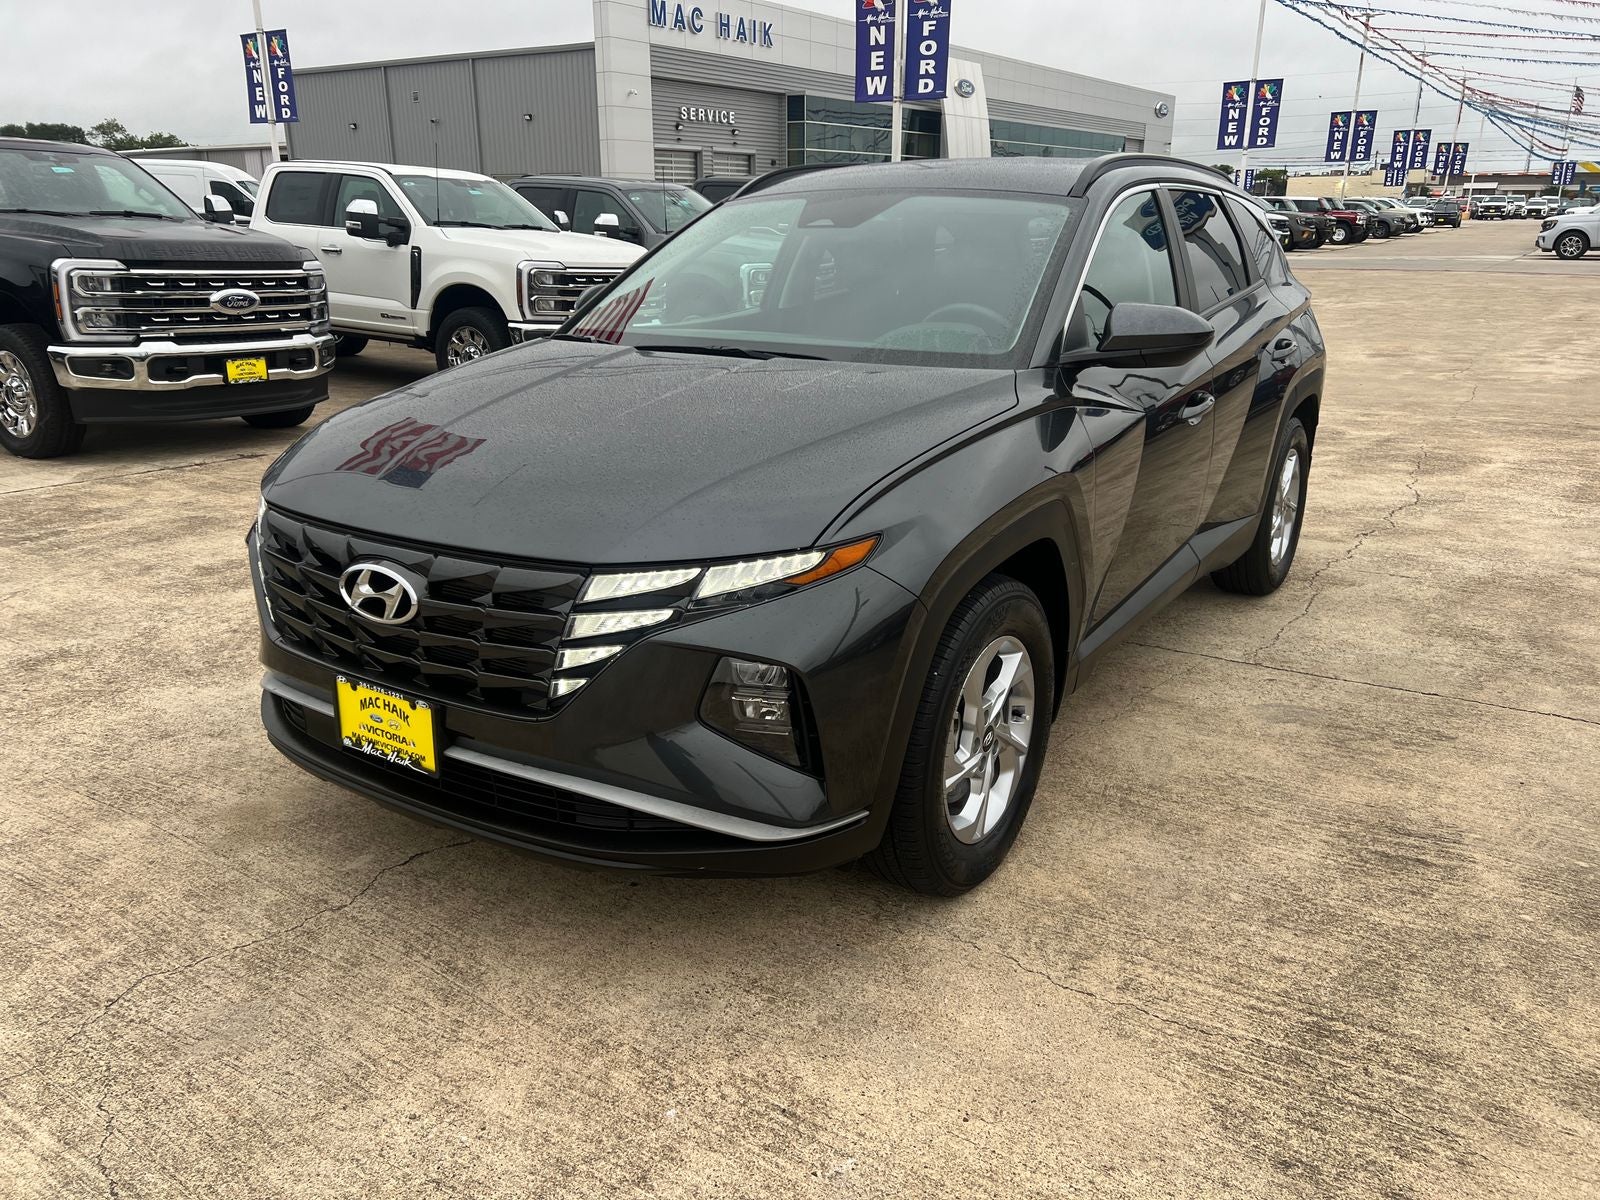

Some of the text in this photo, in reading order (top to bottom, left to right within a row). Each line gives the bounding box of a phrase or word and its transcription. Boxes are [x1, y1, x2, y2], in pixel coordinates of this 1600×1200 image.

[650, 0, 773, 47] MAC HAIK
[865, 25, 887, 95] NEW
[918, 20, 937, 93] FORD
[252, 69, 265, 118] NEW
[277, 68, 290, 118] FORD
[681, 106, 735, 123] SERVICE
[1224, 109, 1239, 146] NEW
[1256, 107, 1271, 145] FORD
[1330, 131, 1343, 159] NEW
[1355, 130, 1367, 159] FORD
[1393, 145, 1404, 168] NEW
[1413, 145, 1423, 168] FORD
[1436, 155, 1445, 174] NEW
[1453, 155, 1462, 174] FORD
[226, 295, 250, 307] Ford
[360, 697, 380, 711] MAC
[383, 699, 410, 727] HAIK
[365, 724, 408, 746] VICTORIA
[361, 742, 412, 766] Mac Haik
